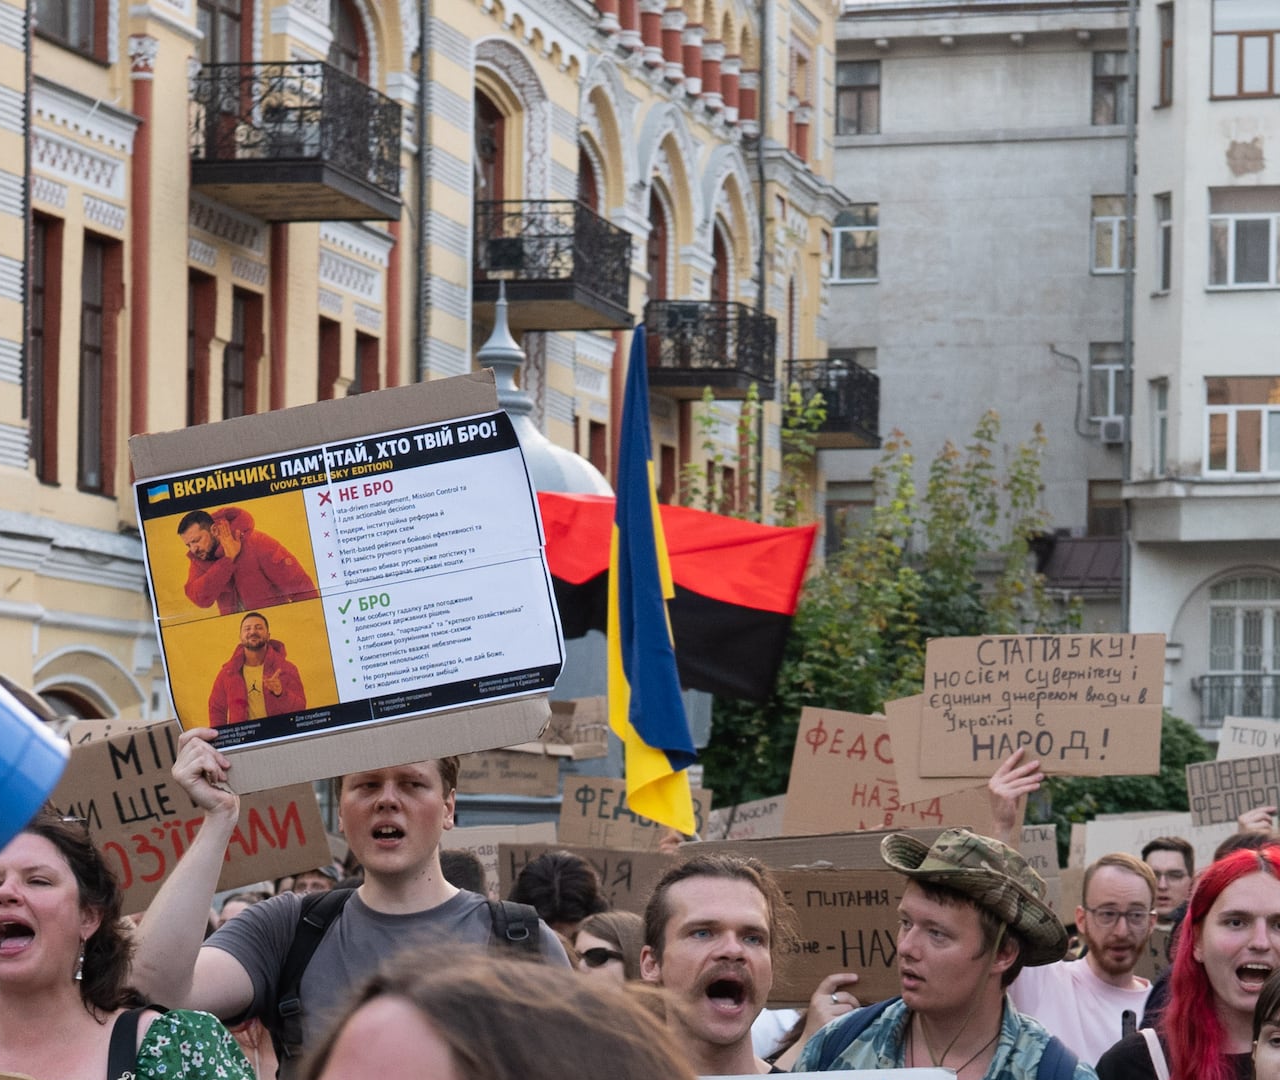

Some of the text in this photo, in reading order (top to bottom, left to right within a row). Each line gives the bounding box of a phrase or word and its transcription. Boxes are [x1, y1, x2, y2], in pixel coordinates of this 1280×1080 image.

[173, 463, 276, 498] ВКРАЇНЧИК!
[376, 438, 410, 458] ХТО
[414, 426, 453, 450] ТВІЙ
[457, 420, 497, 443] БРО!
[270, 478, 298, 492] (VOVA
[352, 459, 394, 477] EDITION)
[339, 479, 393, 502] НЕ БРО
[370, 496, 411, 508] management,
[412, 491, 435, 499] Mission
[436, 485, 459, 495] Control
[356, 509, 387, 519] actionable
[388, 504, 416, 513] decisions
[409, 511, 438, 523] реформа
[359, 592, 390, 611] БРО
[977, 636, 1137, 665] СТАТТЯ 5 КУ!
[972, 728, 1110, 761] НАРОД!
[1230, 726, 1266, 747] TETO
[112, 783, 176, 825] ЩЕ
[807, 889, 890, 907] ПИТАННЯ
